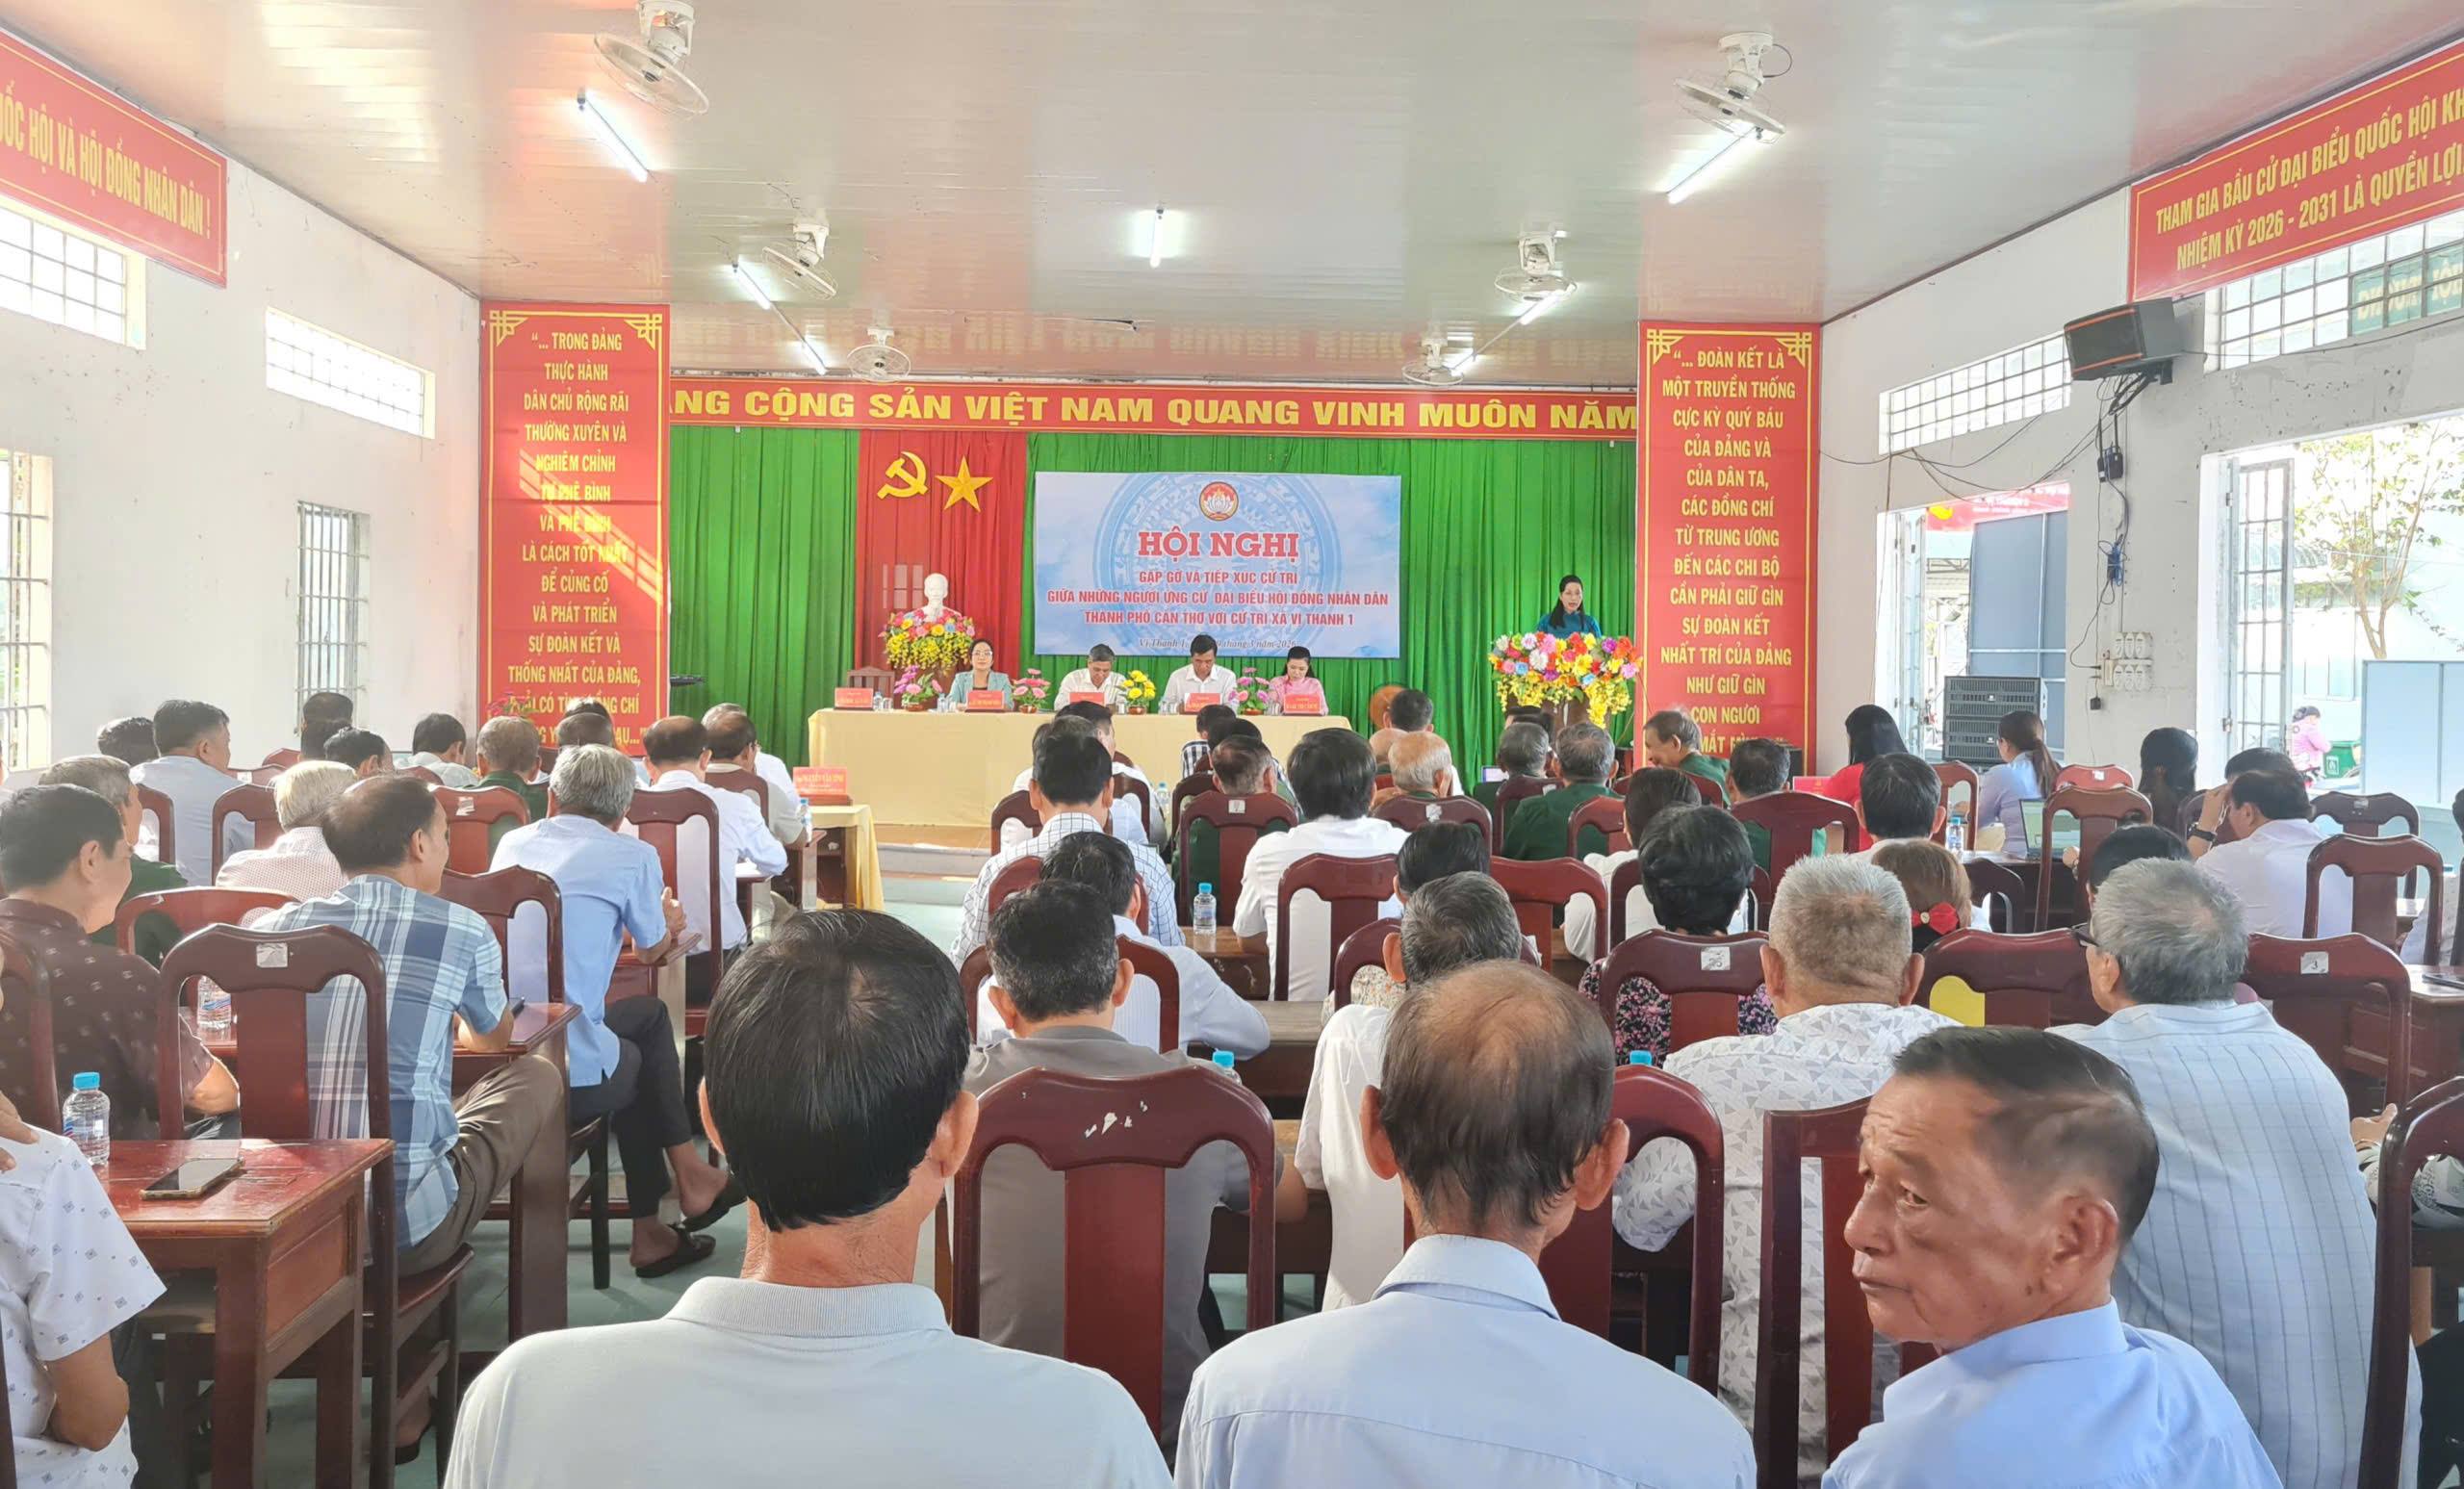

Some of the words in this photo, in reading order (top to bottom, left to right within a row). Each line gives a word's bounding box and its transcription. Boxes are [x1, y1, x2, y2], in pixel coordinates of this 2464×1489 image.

[29, 103, 54, 174] HỘI
[58, 116, 77, 178] VÀ
[80, 128, 104, 196] HỘI
[144, 166, 177, 224] NHÂN
[180, 180, 204, 236] DÂN
[2156, 196, 2193, 235] THAM
[2196, 187, 2220, 218] GIA
[2222, 167, 2252, 209] BẦU
[2256, 155, 2278, 197] CỬ
[2280, 150, 2307, 190] ĐẠI
[2312, 125, 2349, 175] BIỂU
[2354, 105, 2402, 158] QUỐC
[2408, 94, 2437, 140] HỘI
[2177, 224, 2221, 270] NHIỆM
[2224, 218, 2245, 255] KỲ
[2247, 209, 2284, 247] 2026
[2298, 189, 2337, 229] 2031
[2344, 174, 2365, 215] LÀ
[2370, 149, 2427, 207] QUYỀN
[552, 332, 588, 350] TRONG
[591, 326, 622, 351] ĐẢNG
[1698, 347, 1733, 368] ĐOÀN
[1737, 346, 1763, 369] KẾT
[1767, 348, 1784, 369] LÀ
[545, 360, 575, 384] THỰC
[578, 359, 608, 381] HÀNH
[524, 388, 548, 411] DÂN
[550, 386, 573, 411] CHỦ
[577, 389, 606, 415] RỘNG
[610, 389, 629, 412] RÃI
[1662, 375, 1691, 401] MỘT
[1694, 373, 1748, 398] TRUYỀN
[1750, 374, 1796, 399] THỐNG
[670, 390, 731, 416] NG
[744, 387, 856, 422] CỘNG
[868, 387, 952, 420] SẢN
[963, 391, 1048, 425] VIỆT
[1061, 397, 1153, 424] NAM
[1168, 398, 1299, 426] QUANG
[1312, 400, 1405, 426] VINH
[1419, 398, 1537, 428] MUÔN
[1550, 400, 1637, 429] NĂM
[1673, 407, 1700, 431] CỰC
[1704, 406, 1721, 427] KỲ
[1725, 407, 1753, 428] QUÝ
[1757, 407, 1784, 428] BÁU
[525, 420, 570, 442] THƯỜNG
[573, 421, 609, 443] XUYÊN
[612, 423, 628, 443] VÀ
[1684, 433, 1711, 457] CỦA
[1715, 433, 1752, 458] ĐẢNG
[1755, 436, 1772, 458] VÀ
[581, 449, 616, 473] CHỈNH
[1686, 463, 1713, 487] CỦA
[1717, 466, 1745, 487] DÂN
[1748, 470, 1770, 491] TA,
[1681, 493, 1707, 517] CÁC
[1711, 492, 1748, 517] ĐỒNG
[1752, 496, 1775, 517] CHÍ
[1138, 526, 1201, 562] HỘI
[1210, 532, 1299, 563] NGHỊ
[1676, 524, 1694, 546] TỪ
[1697, 528, 1740, 547] TRUNG
[1744, 526, 1780, 547] ƯƠNG
[523, 540, 537, 562] LÀ
[540, 540, 570, 562] CÁCH
[1674, 552, 1702, 576] ĐẾN
[1706, 552, 1732, 576] CÁC
[1734, 558, 1758, 577] CHI
[1761, 555, 1781, 579] BỘ
[541, 567, 556, 593] ĐỂ
[560, 570, 590, 593] CỦNG
[593, 569, 609, 593] CỐ
[1670, 579, 1697, 605] CẦN
[1700, 581, 1732, 605] PHẢI
[1735, 585, 1758, 605] GIỮ
[1761, 585, 1784, 606] GÌN
[533, 602, 548, 623] VÀ
[551, 602, 579, 623] PHÁT
[583, 597, 618, 624] TRIỂN
[1682, 614, 1701, 638] SỰ
[1704, 613, 1740, 635] ĐOÀN
[1744, 611, 1771, 635] KẾT
[528, 632, 544, 656] SỰ
[547, 631, 578, 654] ĐOÀN
[580, 628, 603, 654] KẾT
[606, 631, 622, 654] VÀ
[1661, 639, 1696, 664] NHẤT
[1700, 643, 1723, 664] TRÍ
[1725, 641, 1752, 665] CỦA
[1756, 642, 1792, 666] ĐẢNG
[508, 659, 546, 683] THỐNG
[549, 658, 579, 683] NHẤT
[581, 660, 604, 683] CỦA
[607, 660, 641, 686] ĐẢNG,
[1686, 674, 1715, 695] NHƯ
[1717, 673, 1740, 695] GIỮ
[1743, 673, 1765, 695] GÌN
[540, 692, 554, 713] CÓ
[620, 693, 639, 714] CHÍ
[1691, 706, 1717, 724] CON
